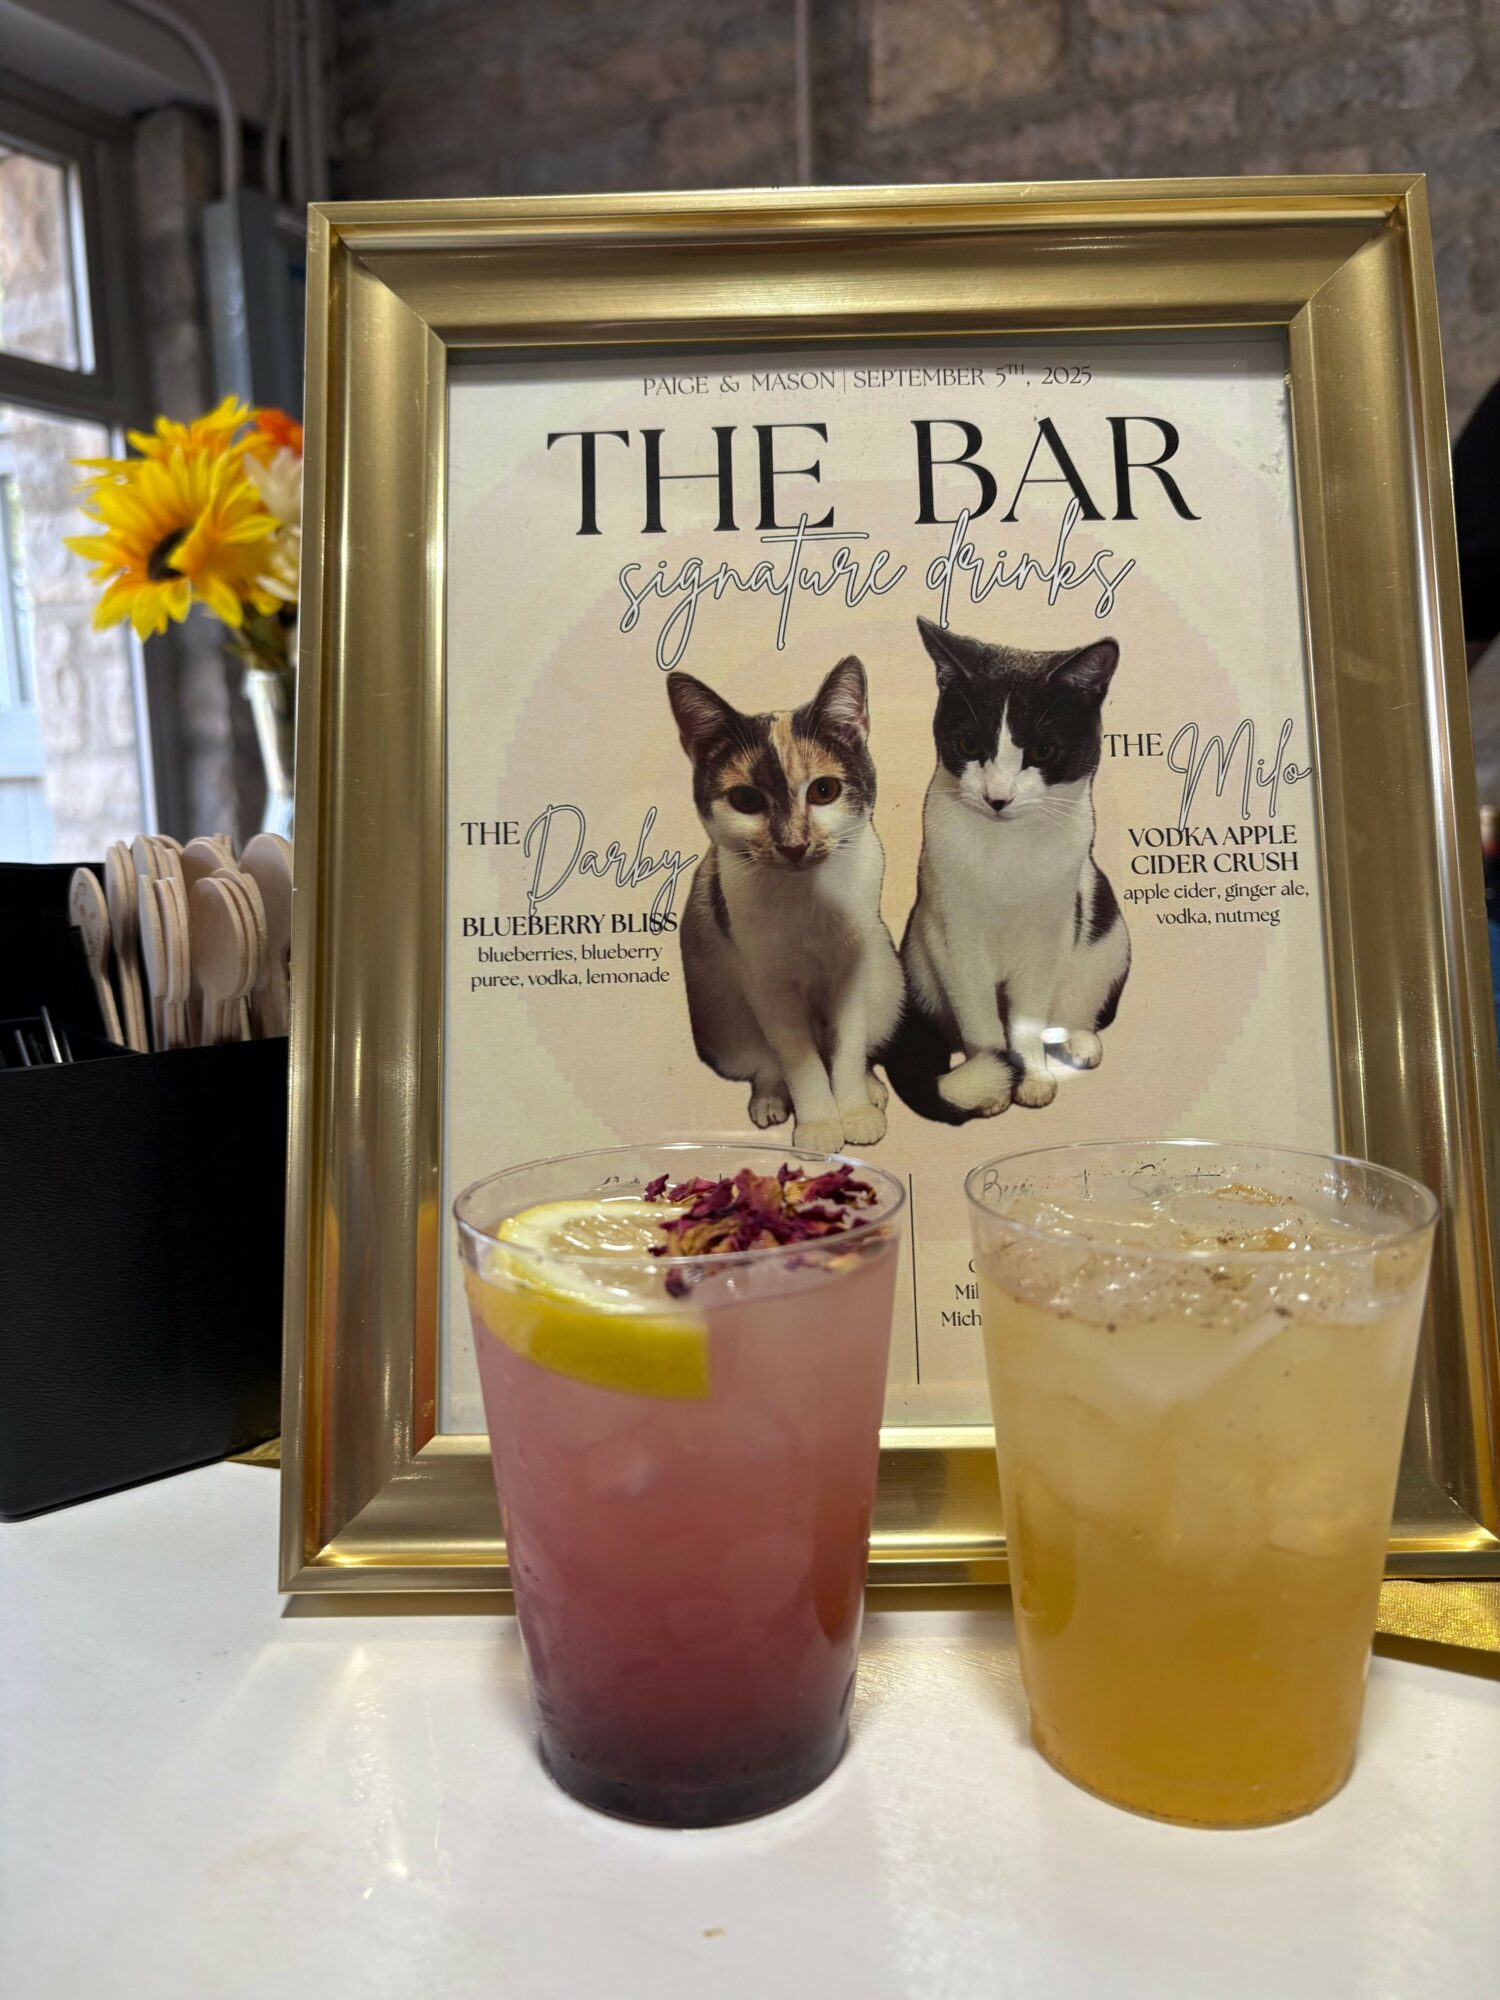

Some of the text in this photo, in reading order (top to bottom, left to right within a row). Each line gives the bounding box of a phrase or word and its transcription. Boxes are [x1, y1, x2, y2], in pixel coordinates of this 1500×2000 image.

[643, 376, 709, 396] PAIGE
[719, 375, 740, 393] &
[751, 371, 836, 392] MASON
[853, 367, 986, 389] SEPTEMBER
[1041, 366, 1092, 386] 2025
[547, 416, 1202, 536] THE BAR
[619, 497, 1136, 671] signature drinks
[1103, 718, 1312, 832] THE Milo
[1128, 824, 1298, 848] VODKA APPLE
[461, 804, 698, 936] THE Darby
[1131, 851, 1299, 875] CIDER CRUSH
[1123, 880, 1309, 905] apple cider, ginger ale,
[462, 911, 678, 936] BLUEBERRY BLISS
[1156, 908, 1281, 927] vodka, nutmeg
[478, 944, 663, 963] blueberries, blueberry
[471, 966, 670, 992] puree, vodka, lemonade
